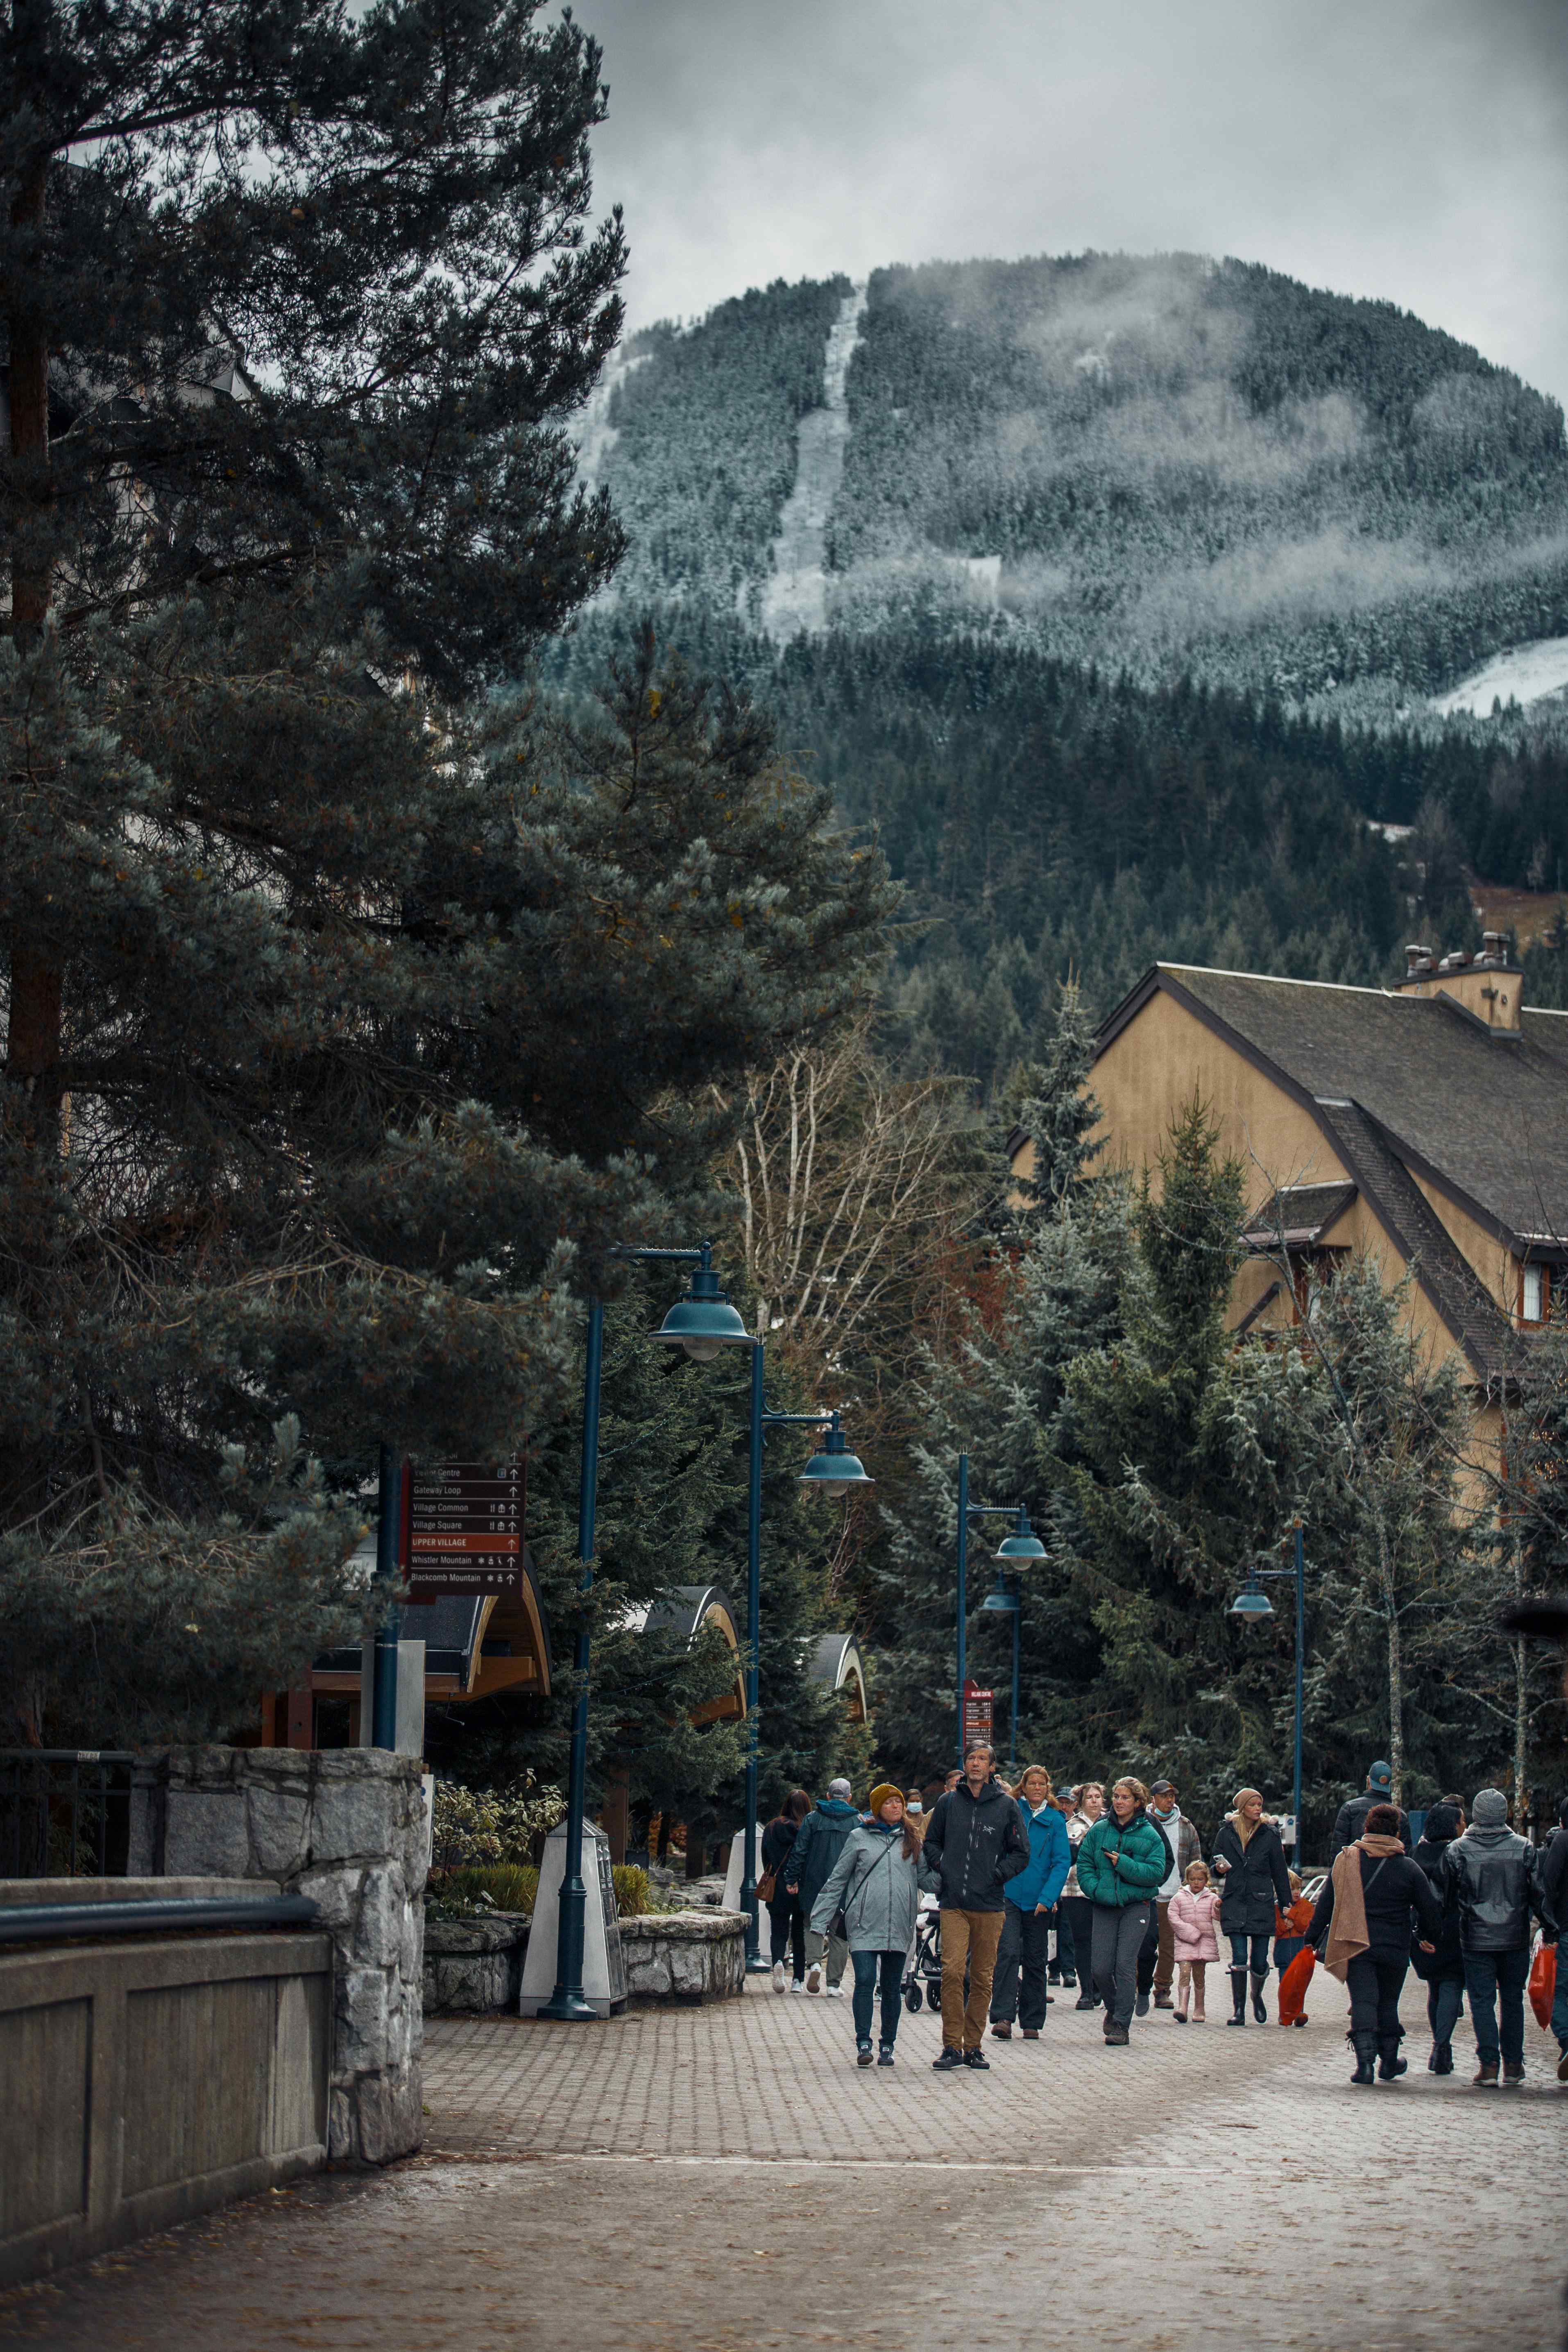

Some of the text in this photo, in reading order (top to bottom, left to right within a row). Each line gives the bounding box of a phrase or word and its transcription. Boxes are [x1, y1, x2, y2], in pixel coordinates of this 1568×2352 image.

[438, 1468, 460, 1477] Centre
[414, 1486, 461, 1496] Gateway Loop
[413, 1503, 436, 1513] Village
[413, 1521, 462, 1531] Village Square
